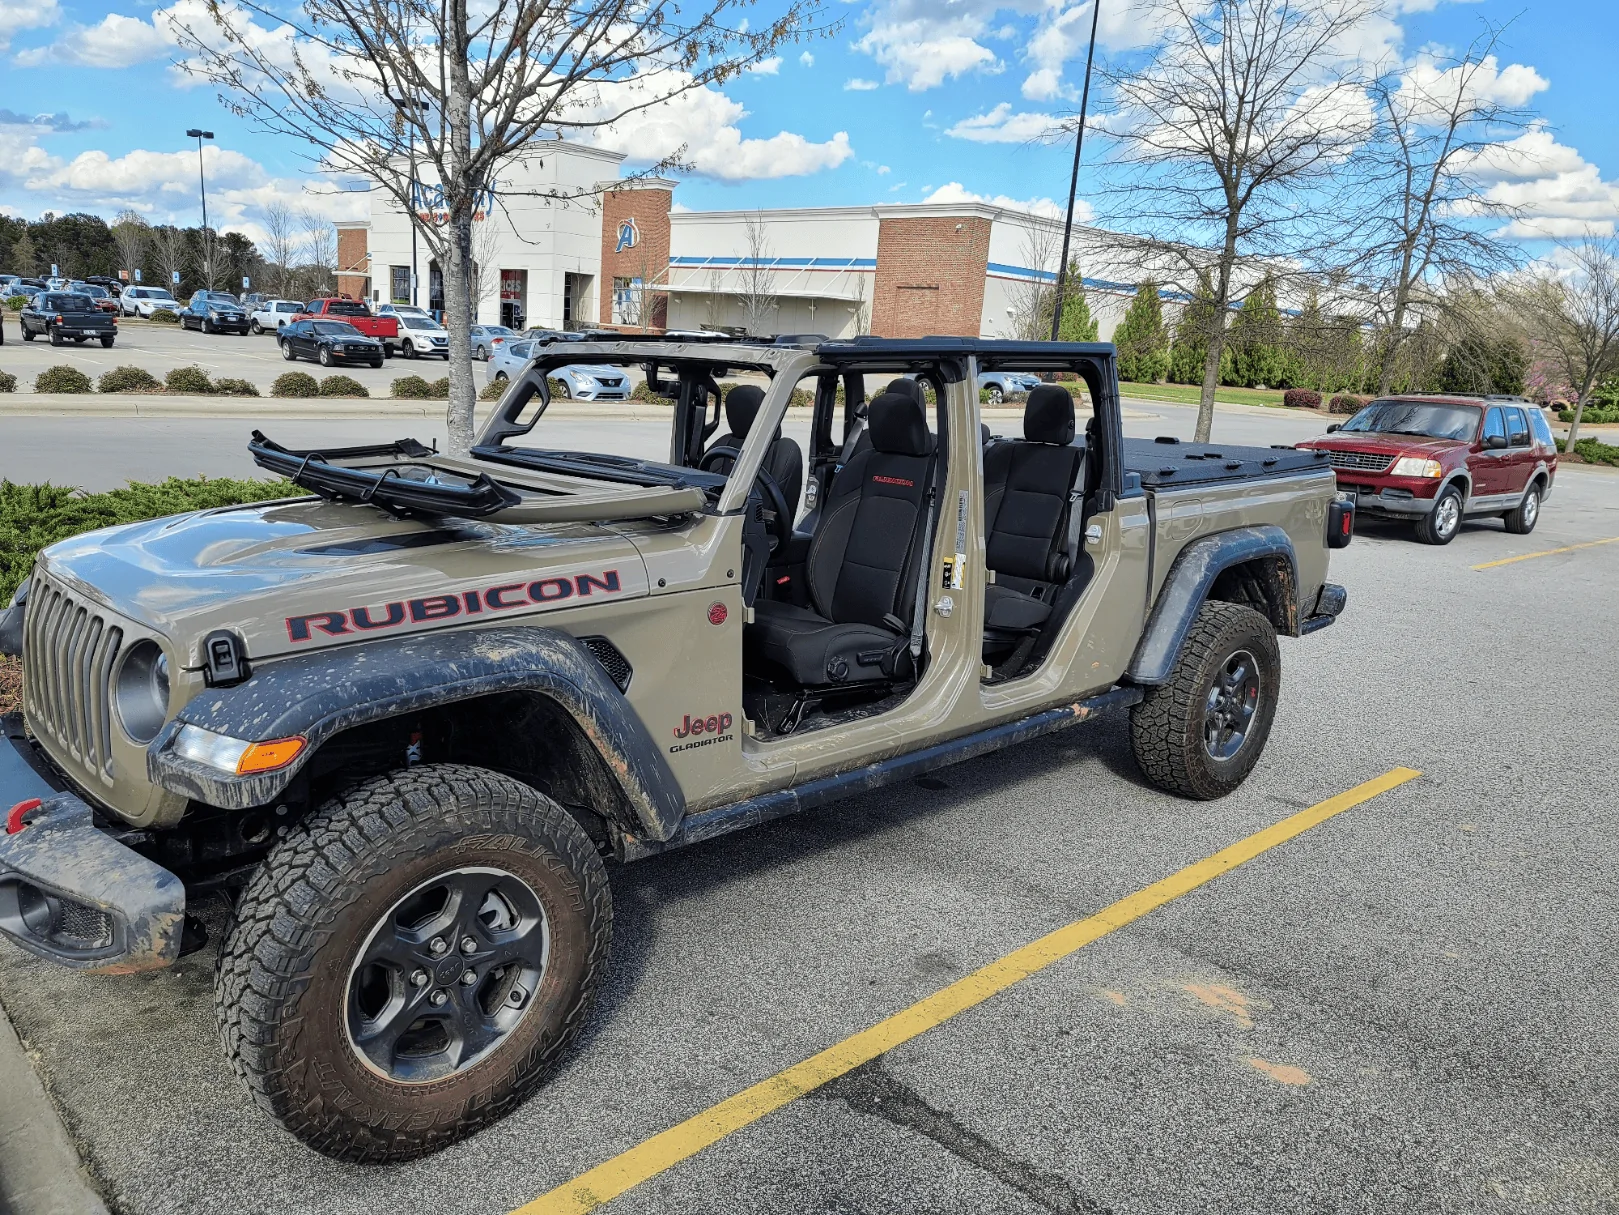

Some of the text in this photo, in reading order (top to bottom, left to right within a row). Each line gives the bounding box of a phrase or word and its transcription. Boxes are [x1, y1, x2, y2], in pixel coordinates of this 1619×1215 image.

[410, 178, 497, 217] Acamy
[285, 569, 622, 643] RUBICON
[673, 711, 733, 739] Jeep
[669, 733, 733, 753] GLADIATOR
